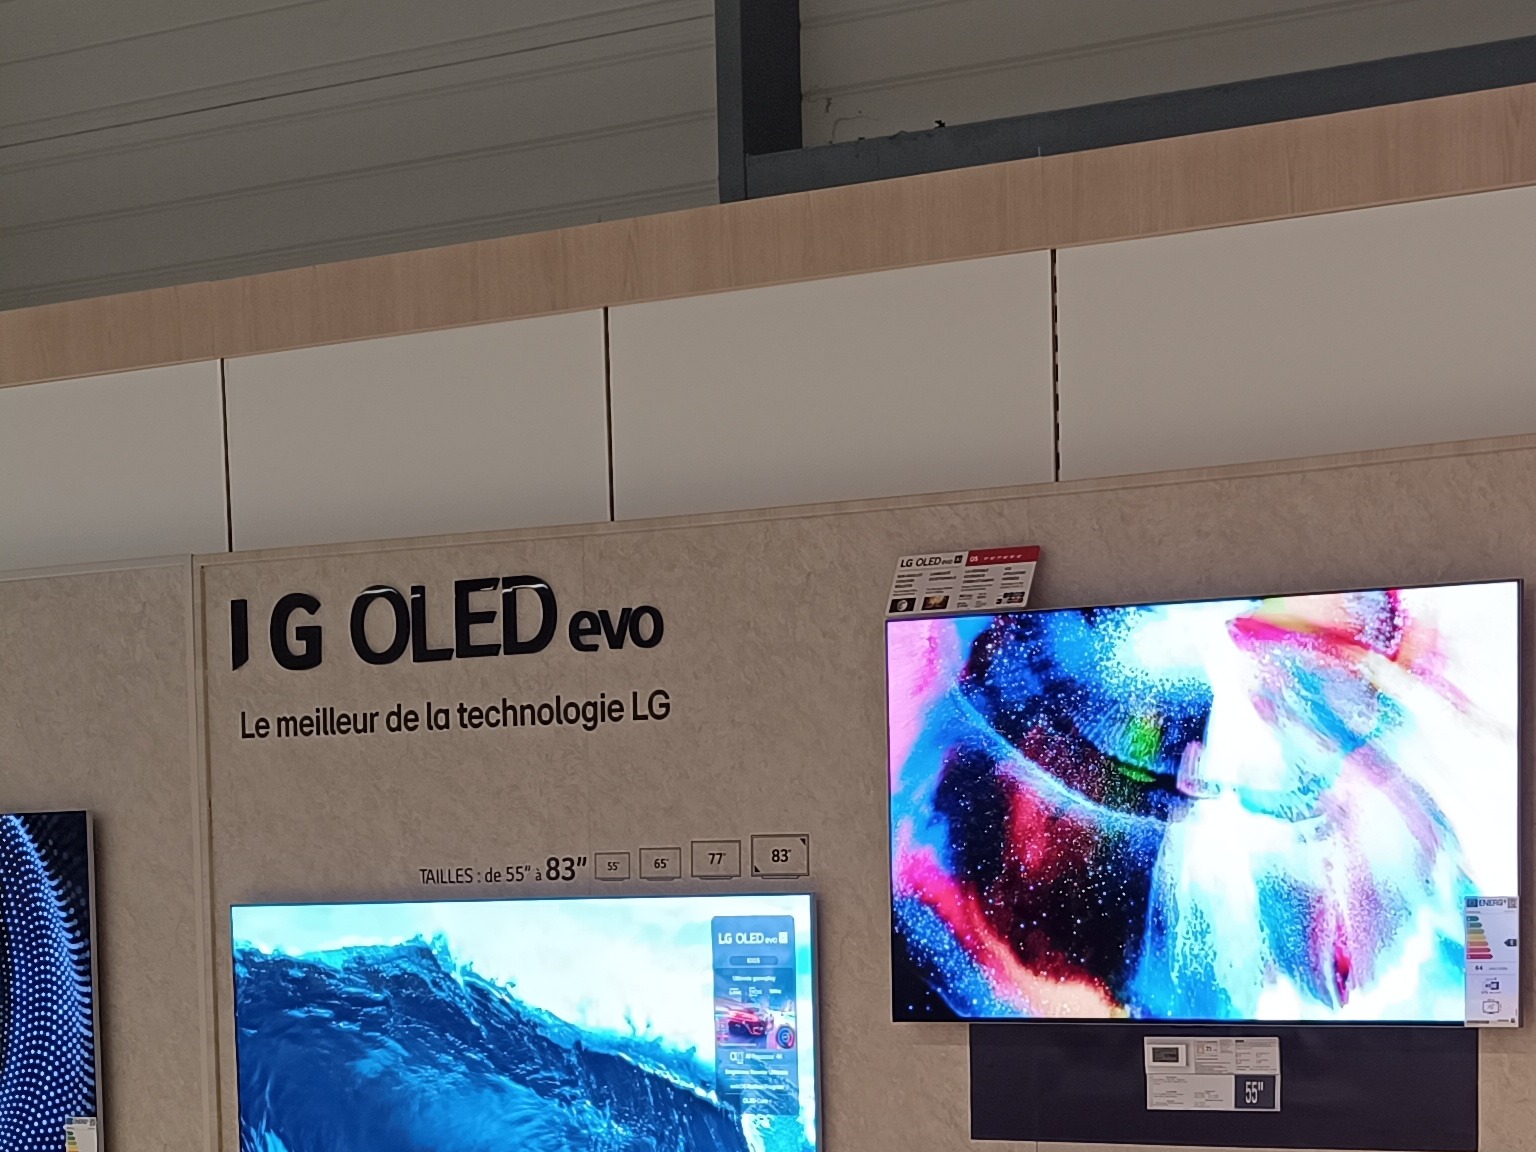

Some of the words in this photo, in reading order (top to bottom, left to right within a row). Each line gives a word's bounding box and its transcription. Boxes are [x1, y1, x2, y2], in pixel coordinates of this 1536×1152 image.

[900, 558, 913, 568] LG
[915, 556, 942, 567] OLED
[350, 574, 558, 666] OLED
[569, 602, 664, 652] evo
[241, 713, 270, 739] Le
[276, 703, 380, 738] meilleur
[385, 702, 420, 733] de
[427, 700, 451, 731] la
[456, 694, 624, 732] technologie
[632, 689, 671, 721] LG
[419, 867, 473, 885] TAILLES
[484, 868, 502, 884] de
[535, 868, 542, 882] à
[545, 856, 587, 882] 83"
[718, 932, 732, 945] LG
[735, 932, 764, 945] OLED
